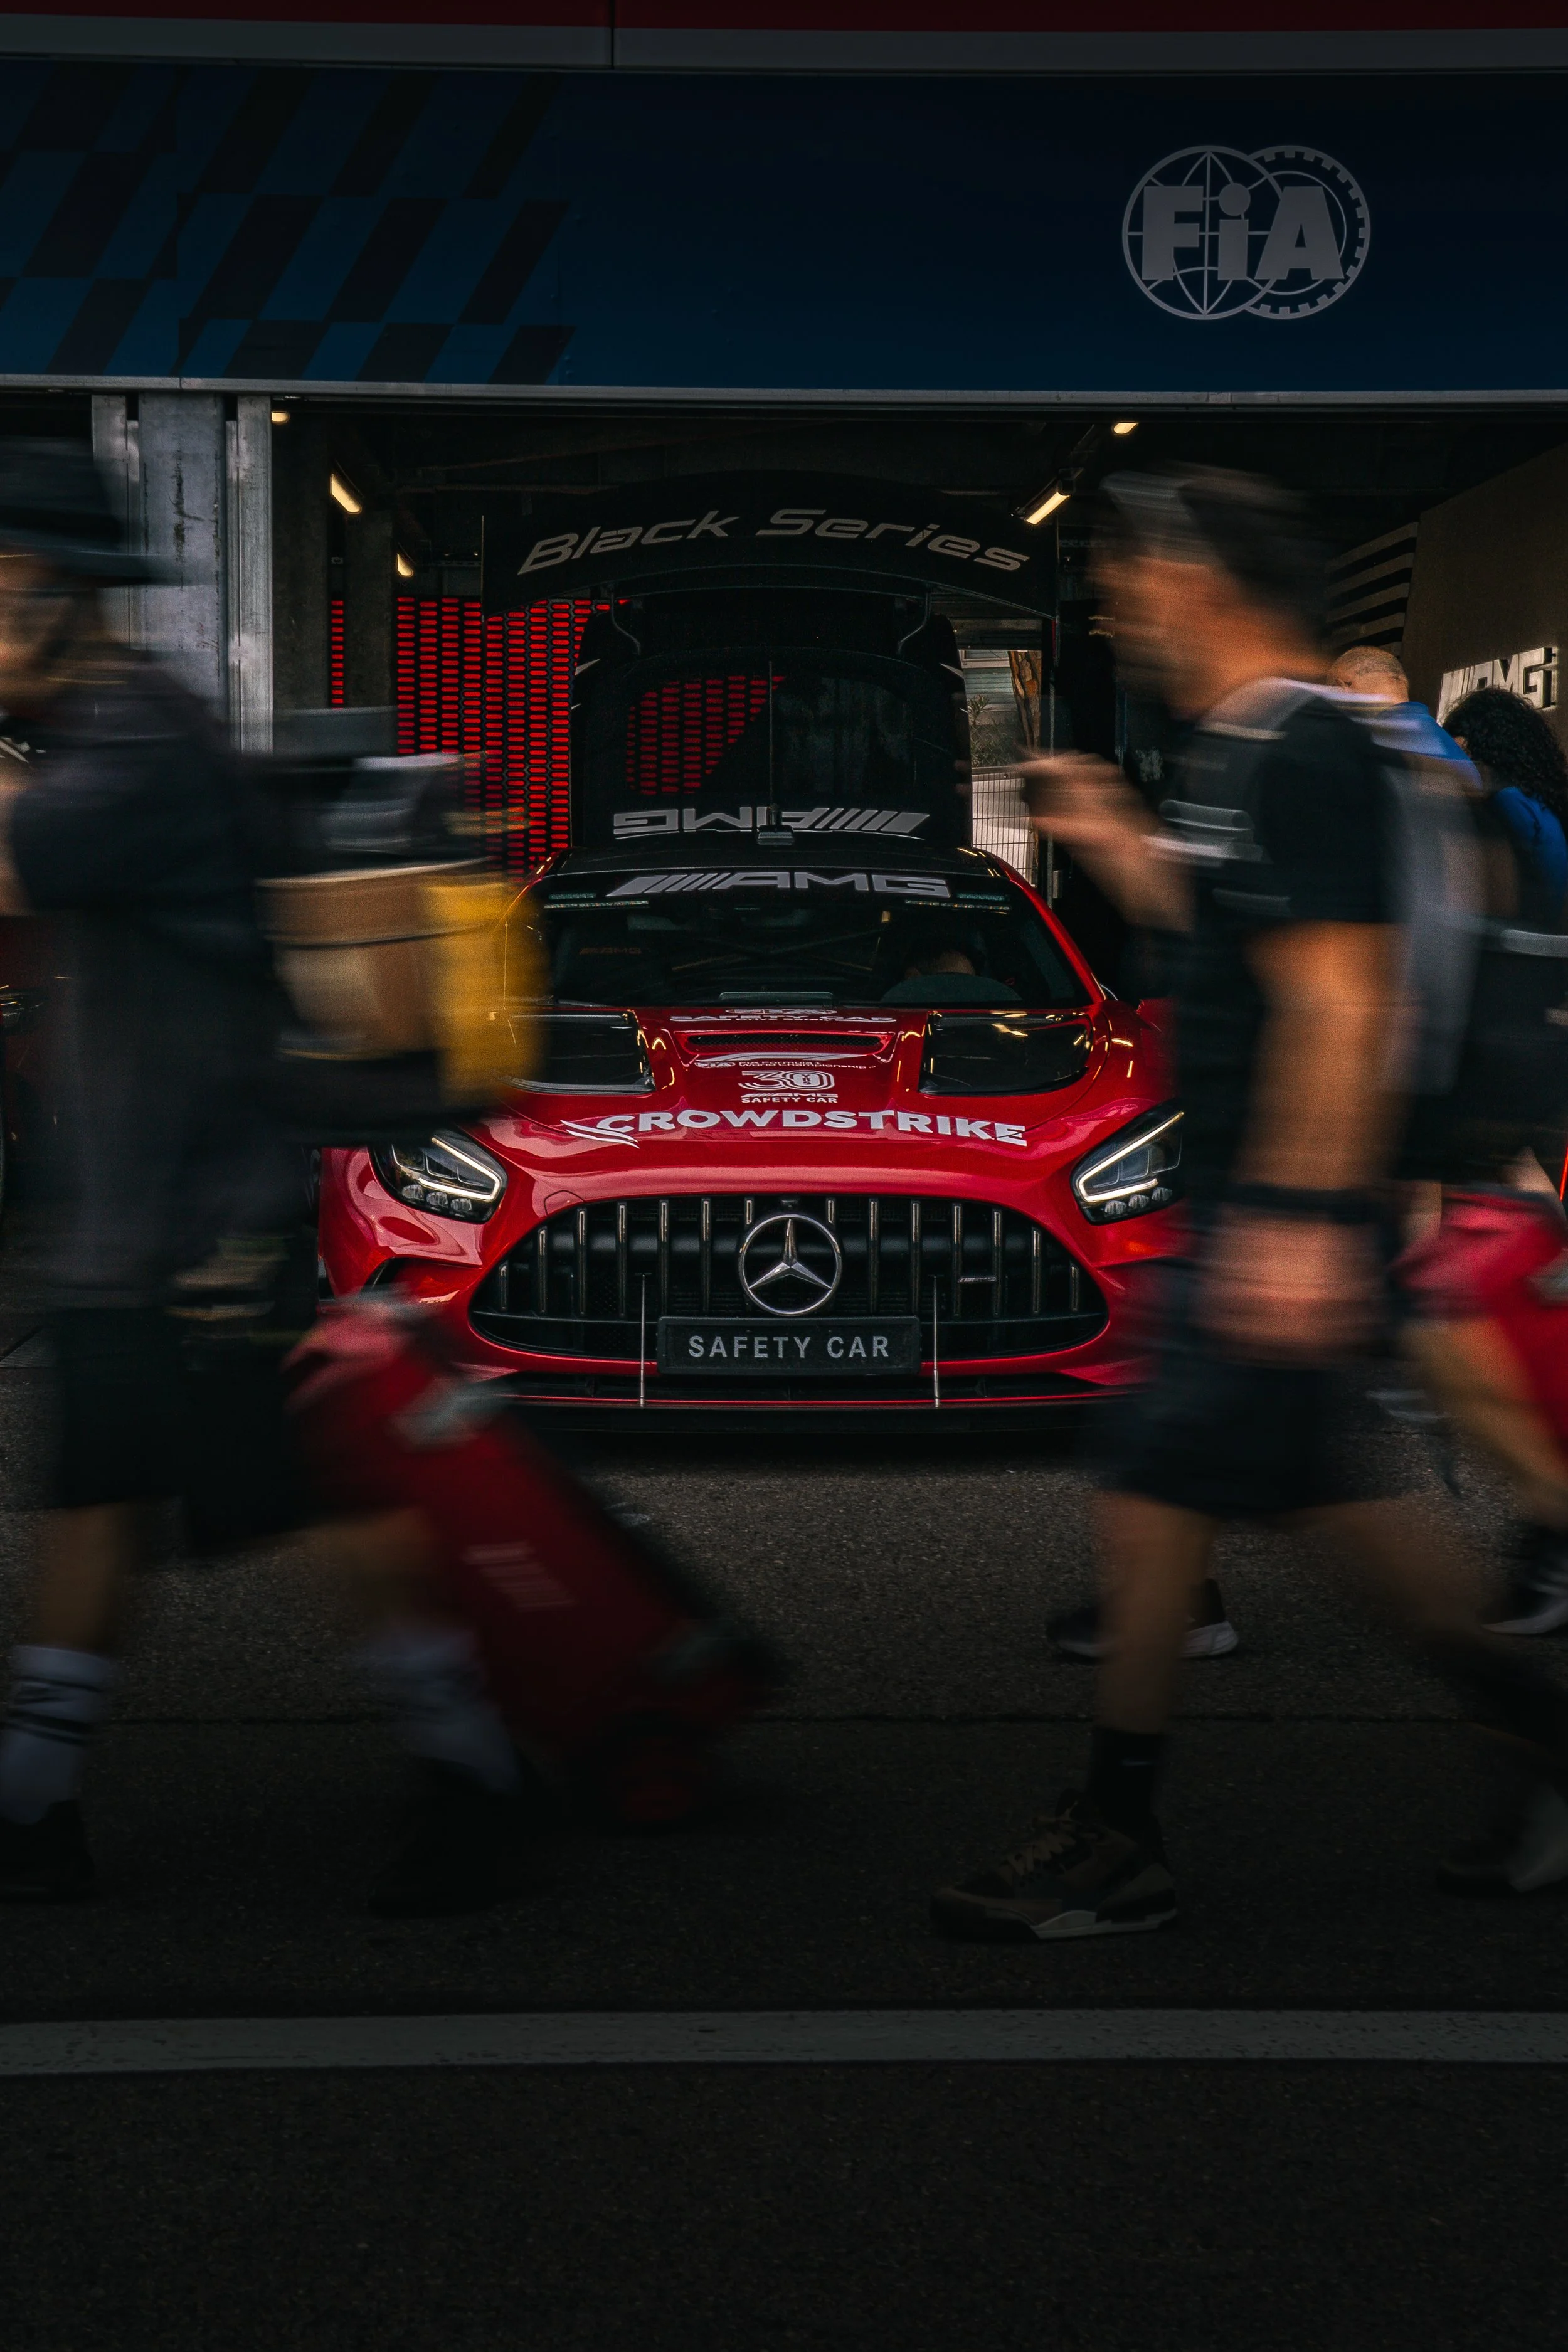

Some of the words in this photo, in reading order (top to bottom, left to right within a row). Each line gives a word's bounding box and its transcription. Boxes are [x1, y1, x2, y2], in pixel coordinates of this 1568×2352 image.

[517, 510, 740, 576] Black
[756, 508, 1030, 571] Series
[712, 871, 951, 898] AMG
[738, 1069, 835, 1091] 30
[596, 1109, 1027, 1147] CROWDSTRIKE
[688, 1335, 812, 1359] SAFETY
[826, 1335, 889, 1359] CAR
